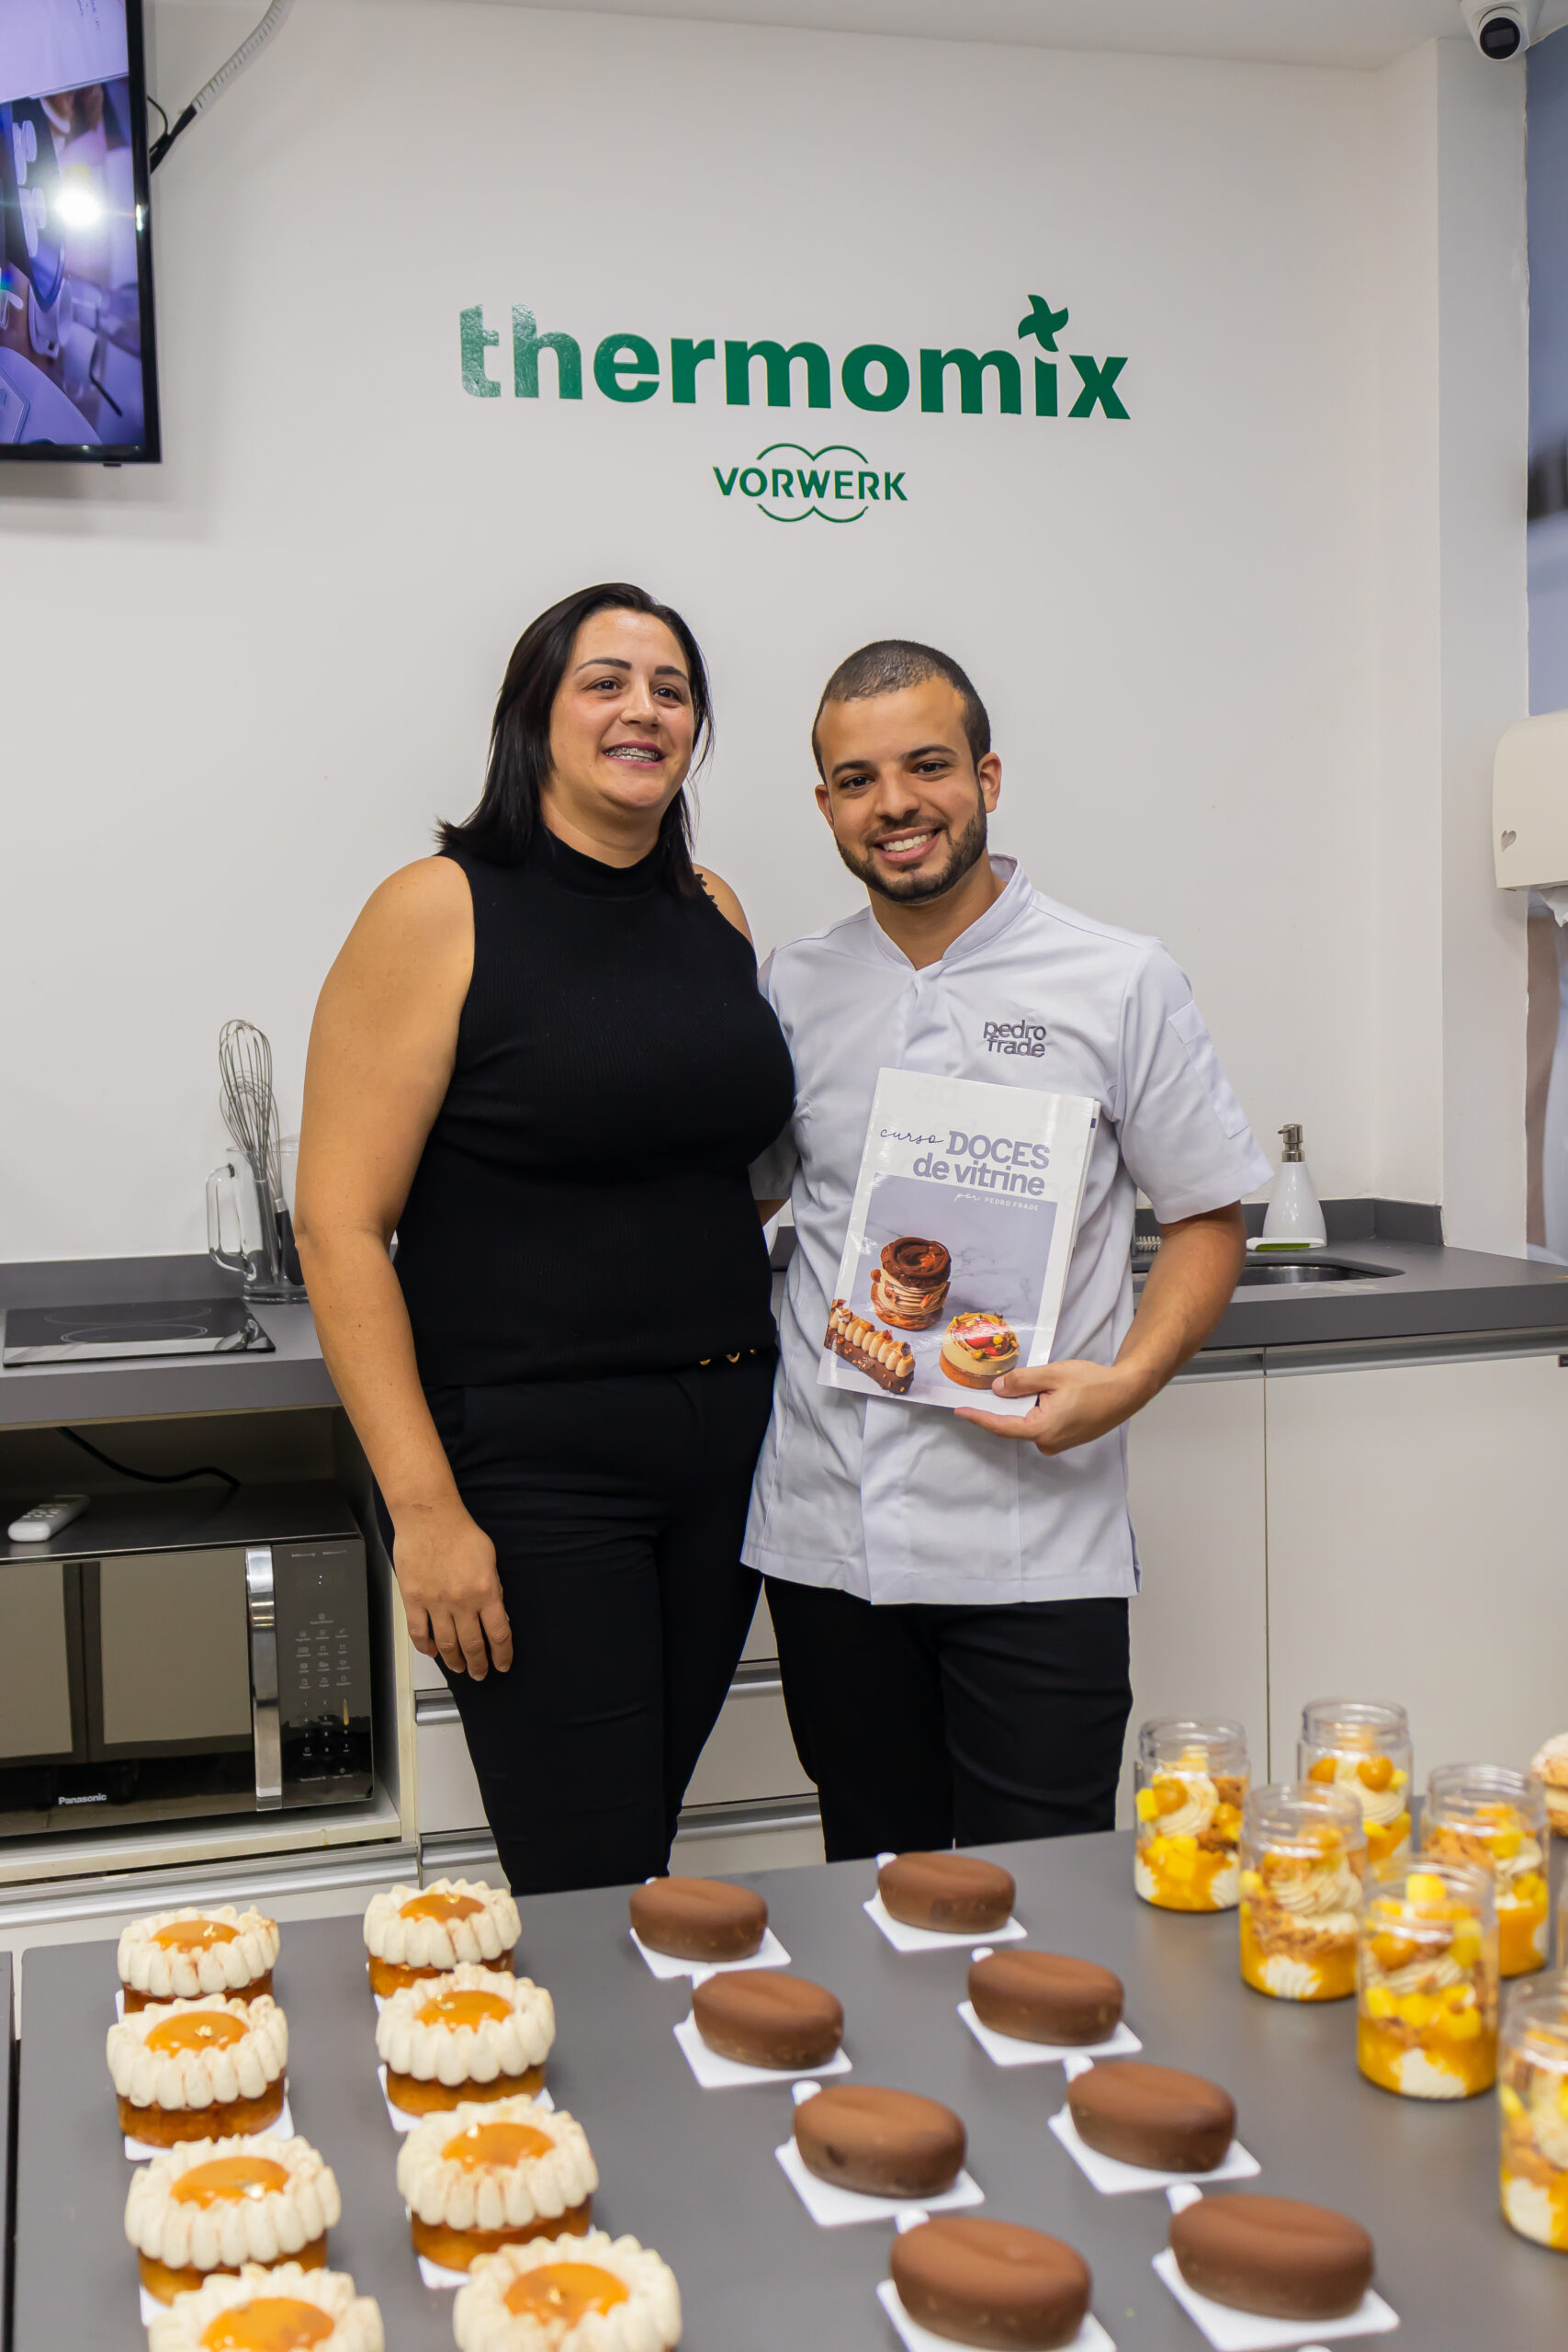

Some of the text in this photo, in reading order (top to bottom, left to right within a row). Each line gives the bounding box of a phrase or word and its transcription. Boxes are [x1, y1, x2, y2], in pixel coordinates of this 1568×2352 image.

[459, 295, 1131, 419] thermomix
[713, 465, 908, 502] VORWERK
[983, 1019, 1047, 1041] pedro
[987, 1035, 1046, 1058] frade
[880, 1128, 1051, 1170] curso DOCES
[912, 1151, 950, 1181] de
[954, 1159, 1045, 1196] vitrine
[984, 1196, 1011, 1207] PEDRO
[1012, 1201, 1040, 1212] FRADE
[58, 1792, 107, 1805] Panasonic
